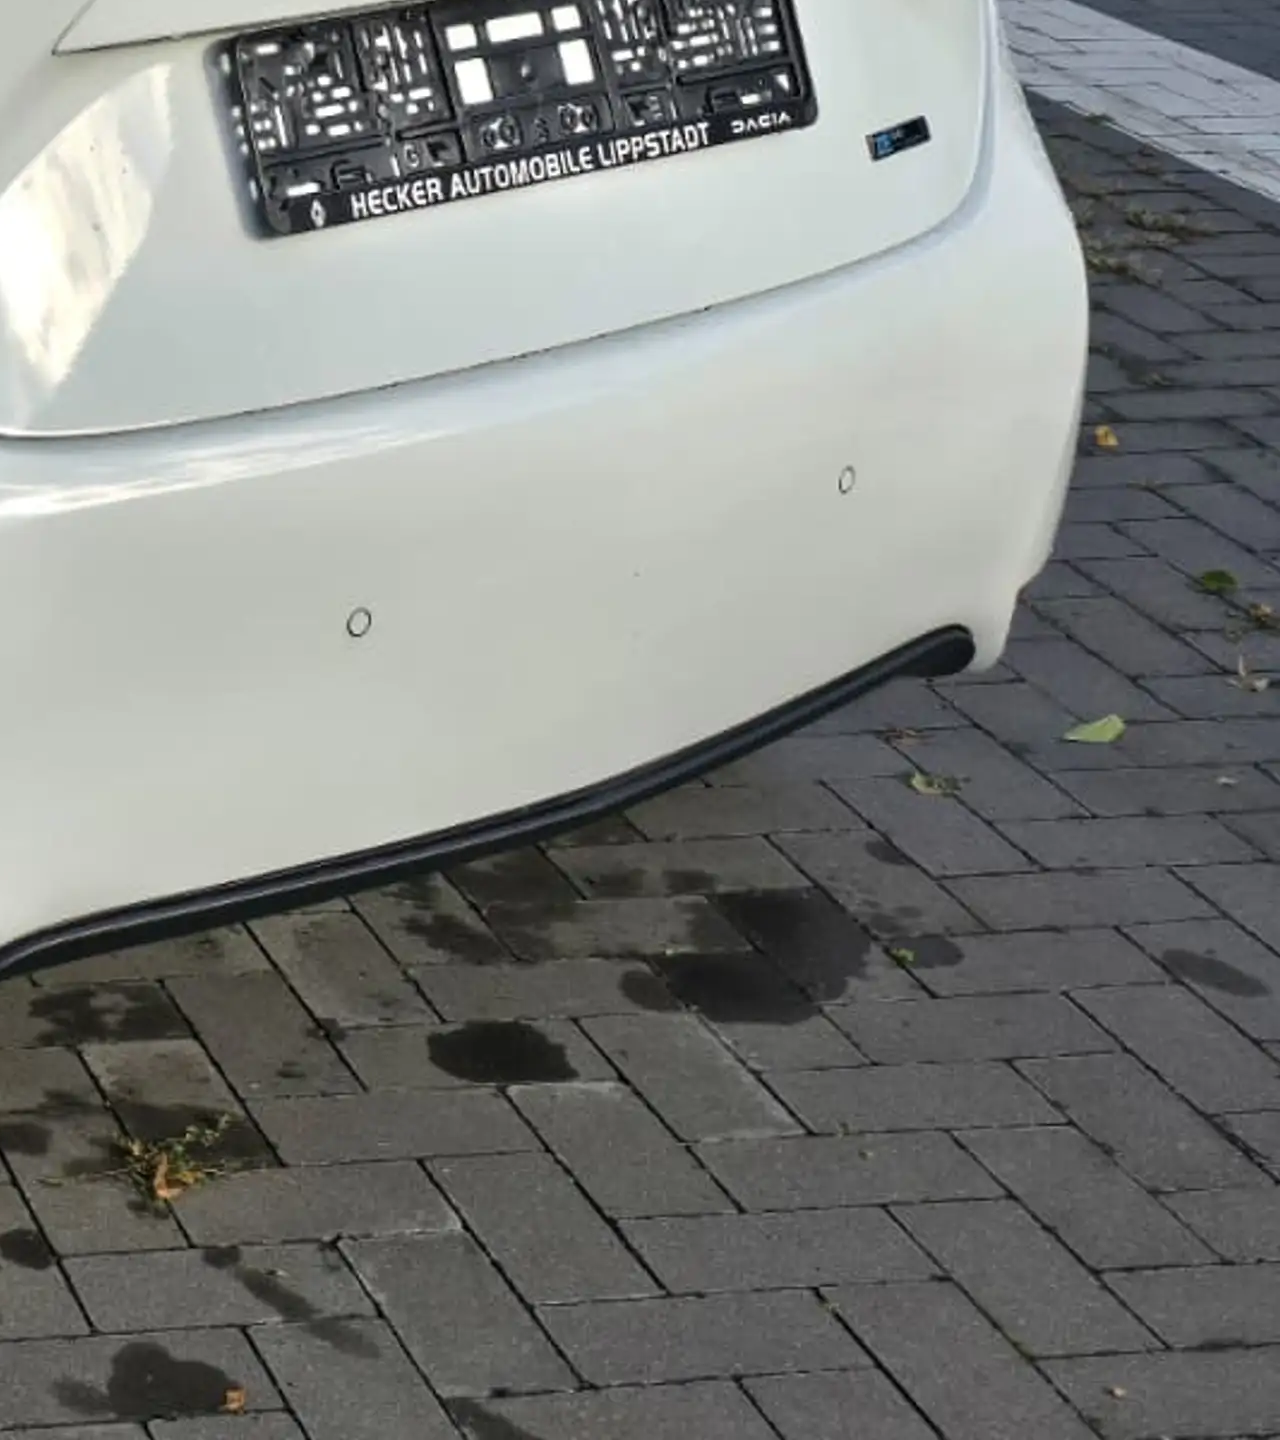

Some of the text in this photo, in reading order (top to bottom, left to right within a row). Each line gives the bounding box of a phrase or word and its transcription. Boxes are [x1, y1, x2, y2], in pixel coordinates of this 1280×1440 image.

[350, 110, 791, 219] HECKER AUTOMOBILE LIPPSTADT DACIA
